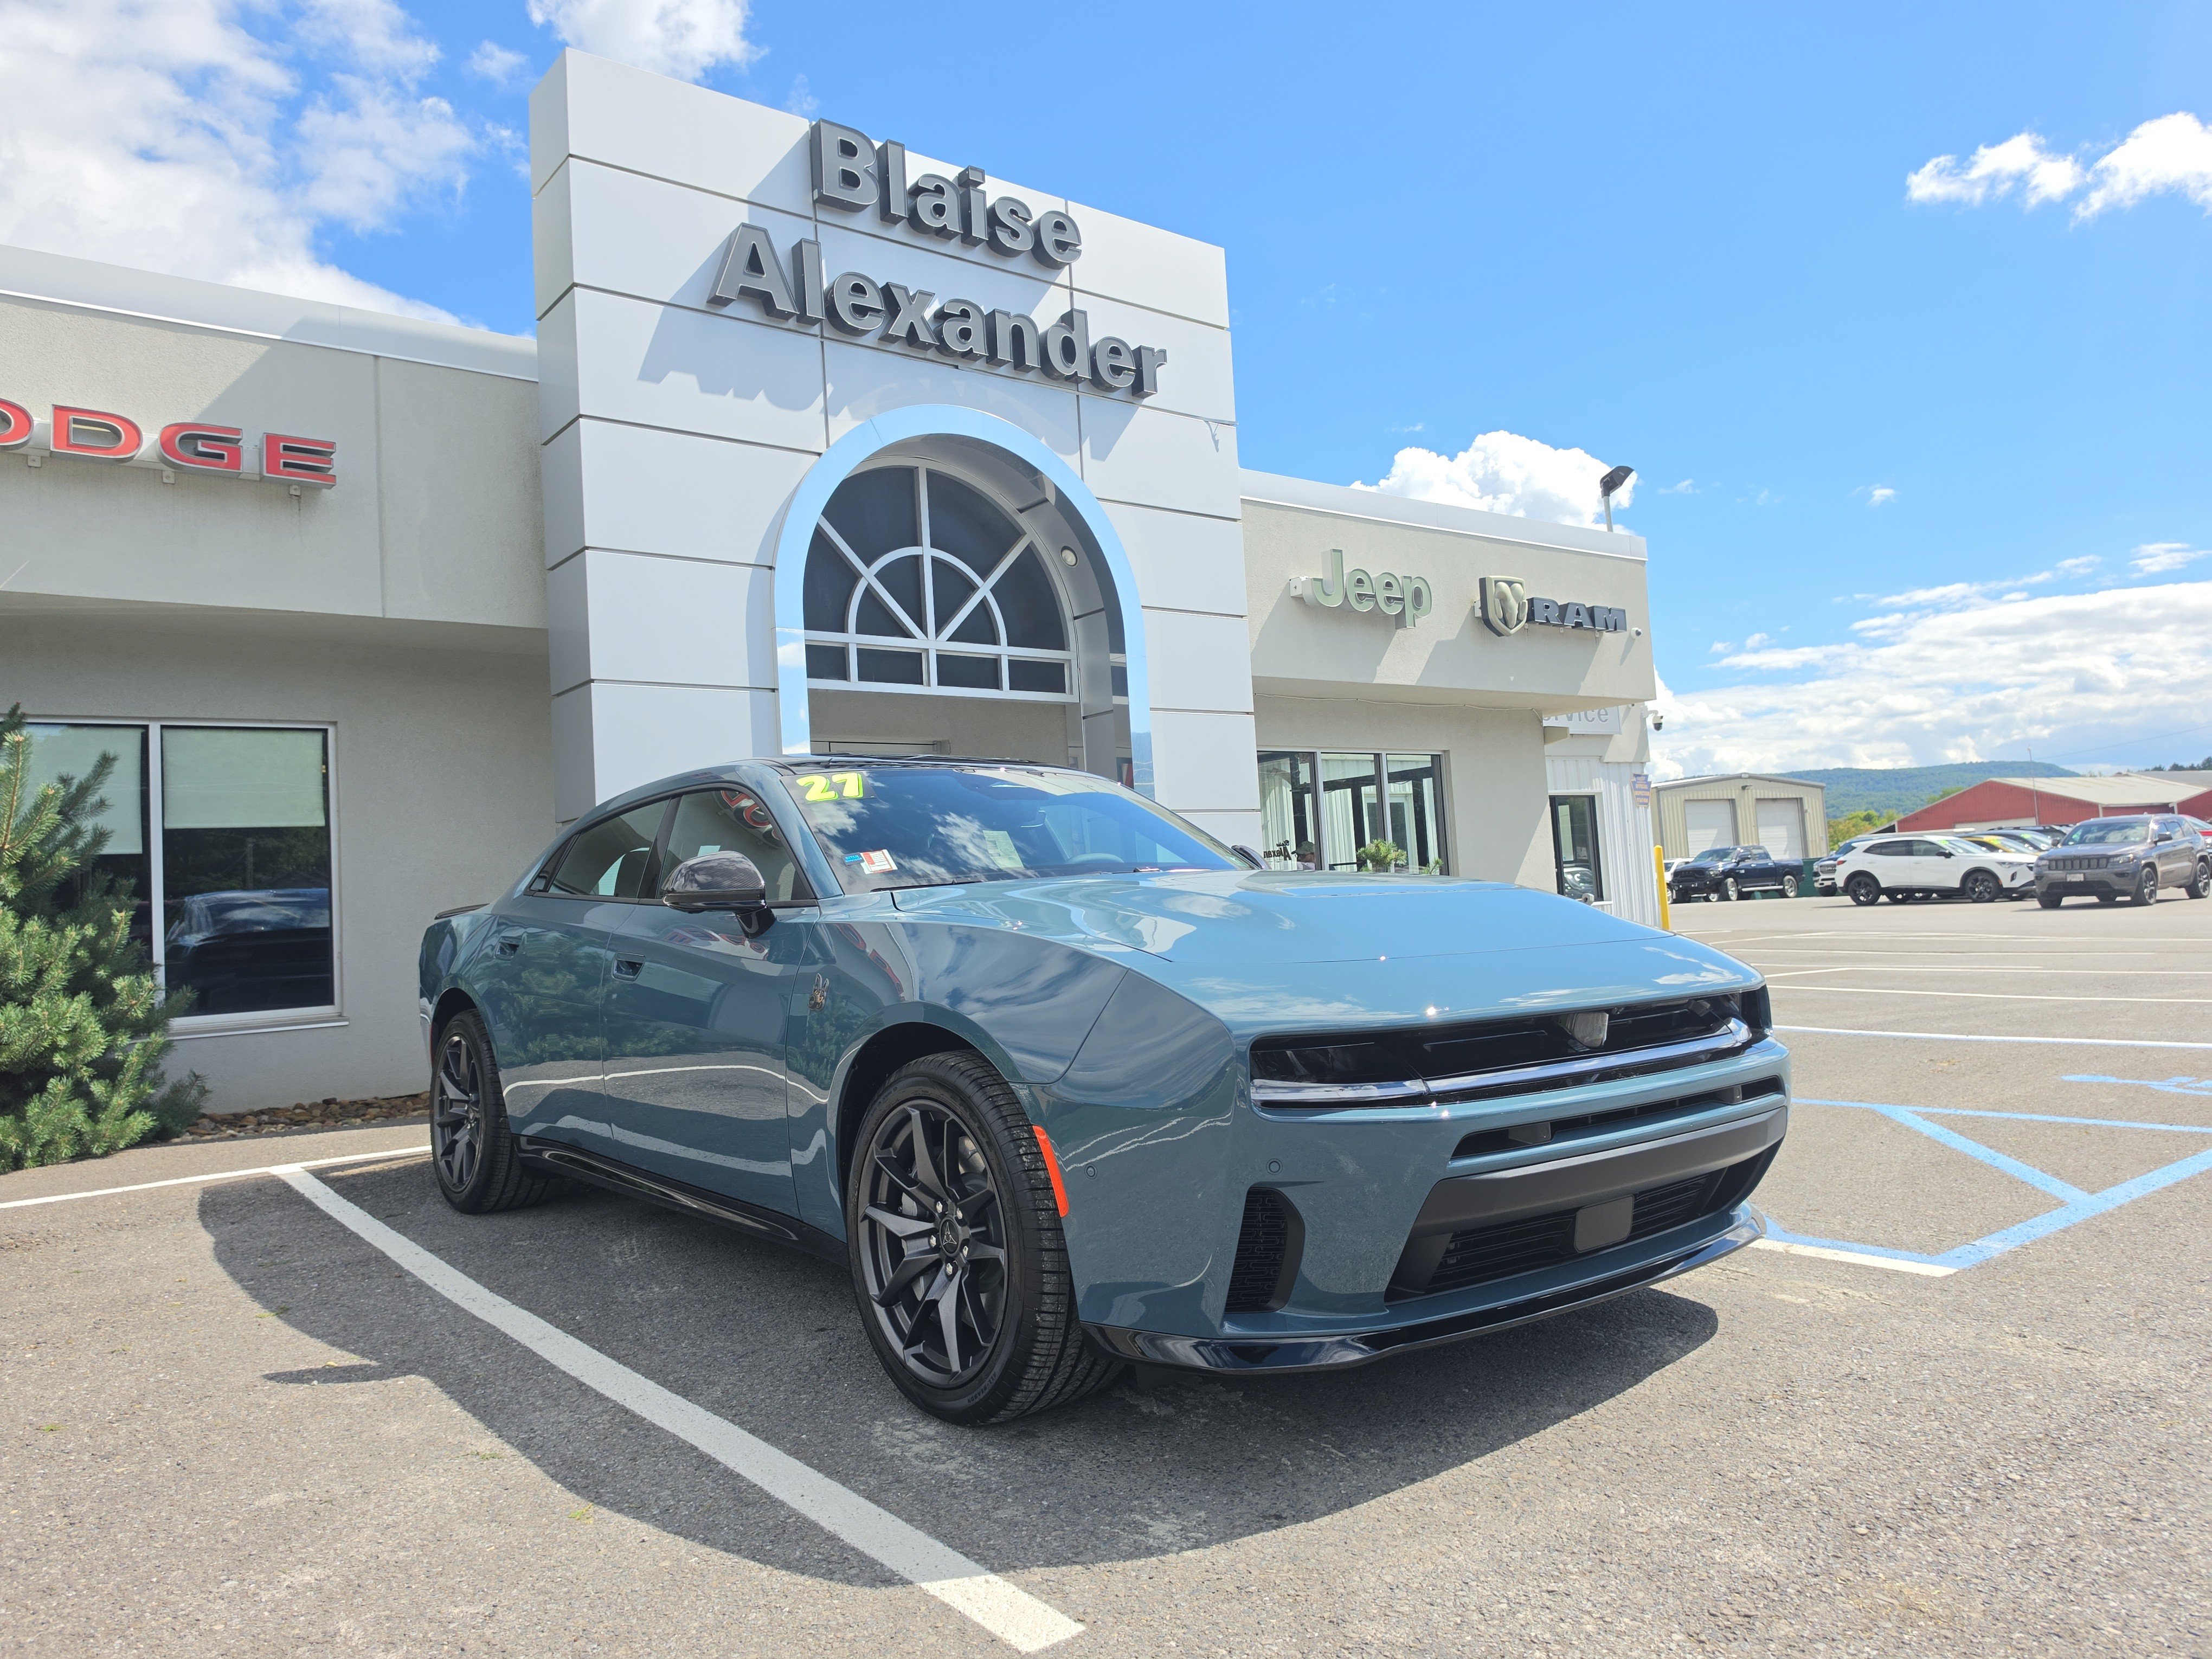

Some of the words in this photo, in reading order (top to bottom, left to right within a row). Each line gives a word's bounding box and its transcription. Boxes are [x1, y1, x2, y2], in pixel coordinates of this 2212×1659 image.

[811, 118, 1082, 269] Blaise
[706, 222, 1167, 398] Alexander
[1302, 549, 1432, 629] Jeep
[1526, 597, 1627, 633] RAM
[796, 773, 863, 801] 27
